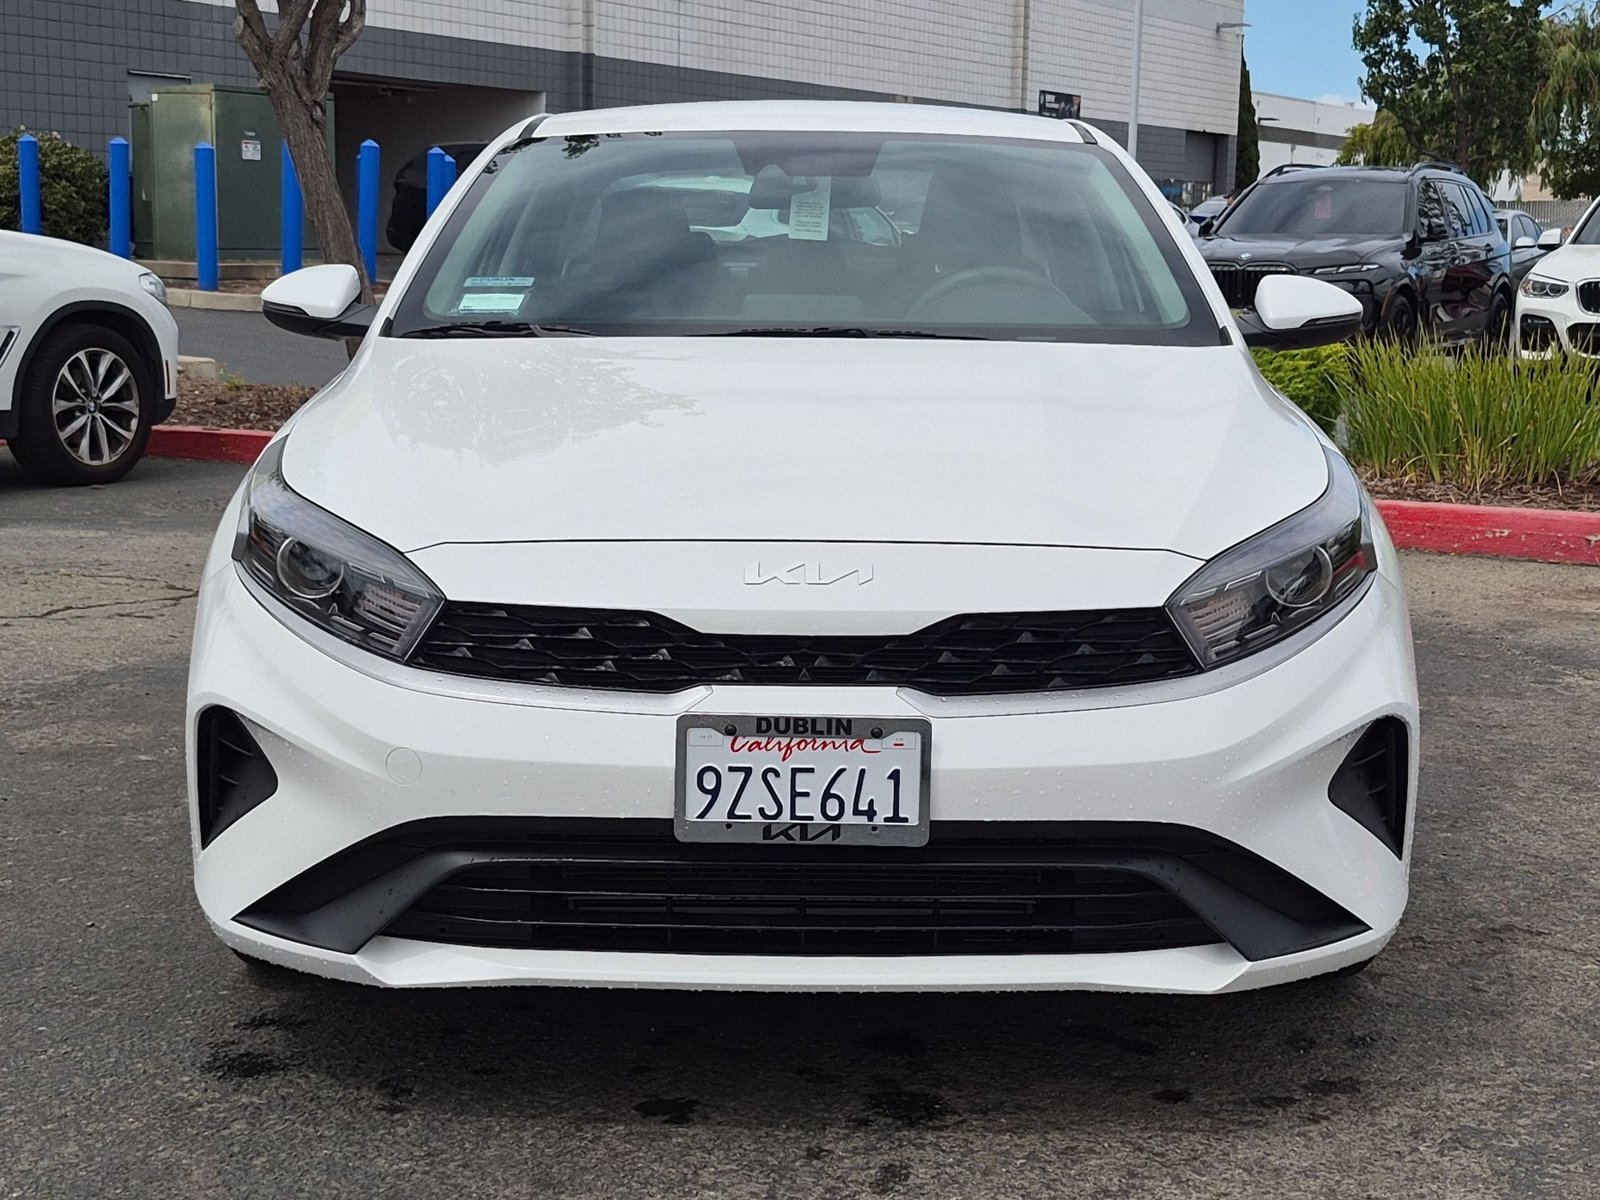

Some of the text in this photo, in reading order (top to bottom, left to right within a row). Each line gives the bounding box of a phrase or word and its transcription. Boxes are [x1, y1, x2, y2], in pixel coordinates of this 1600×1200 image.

[744, 561, 874, 586] KIA
[756, 717, 852, 735] DUBLIN
[730, 736, 881, 762] California
[695, 765, 909, 823] 9ZSE641
[762, 823, 841, 842] KIA
